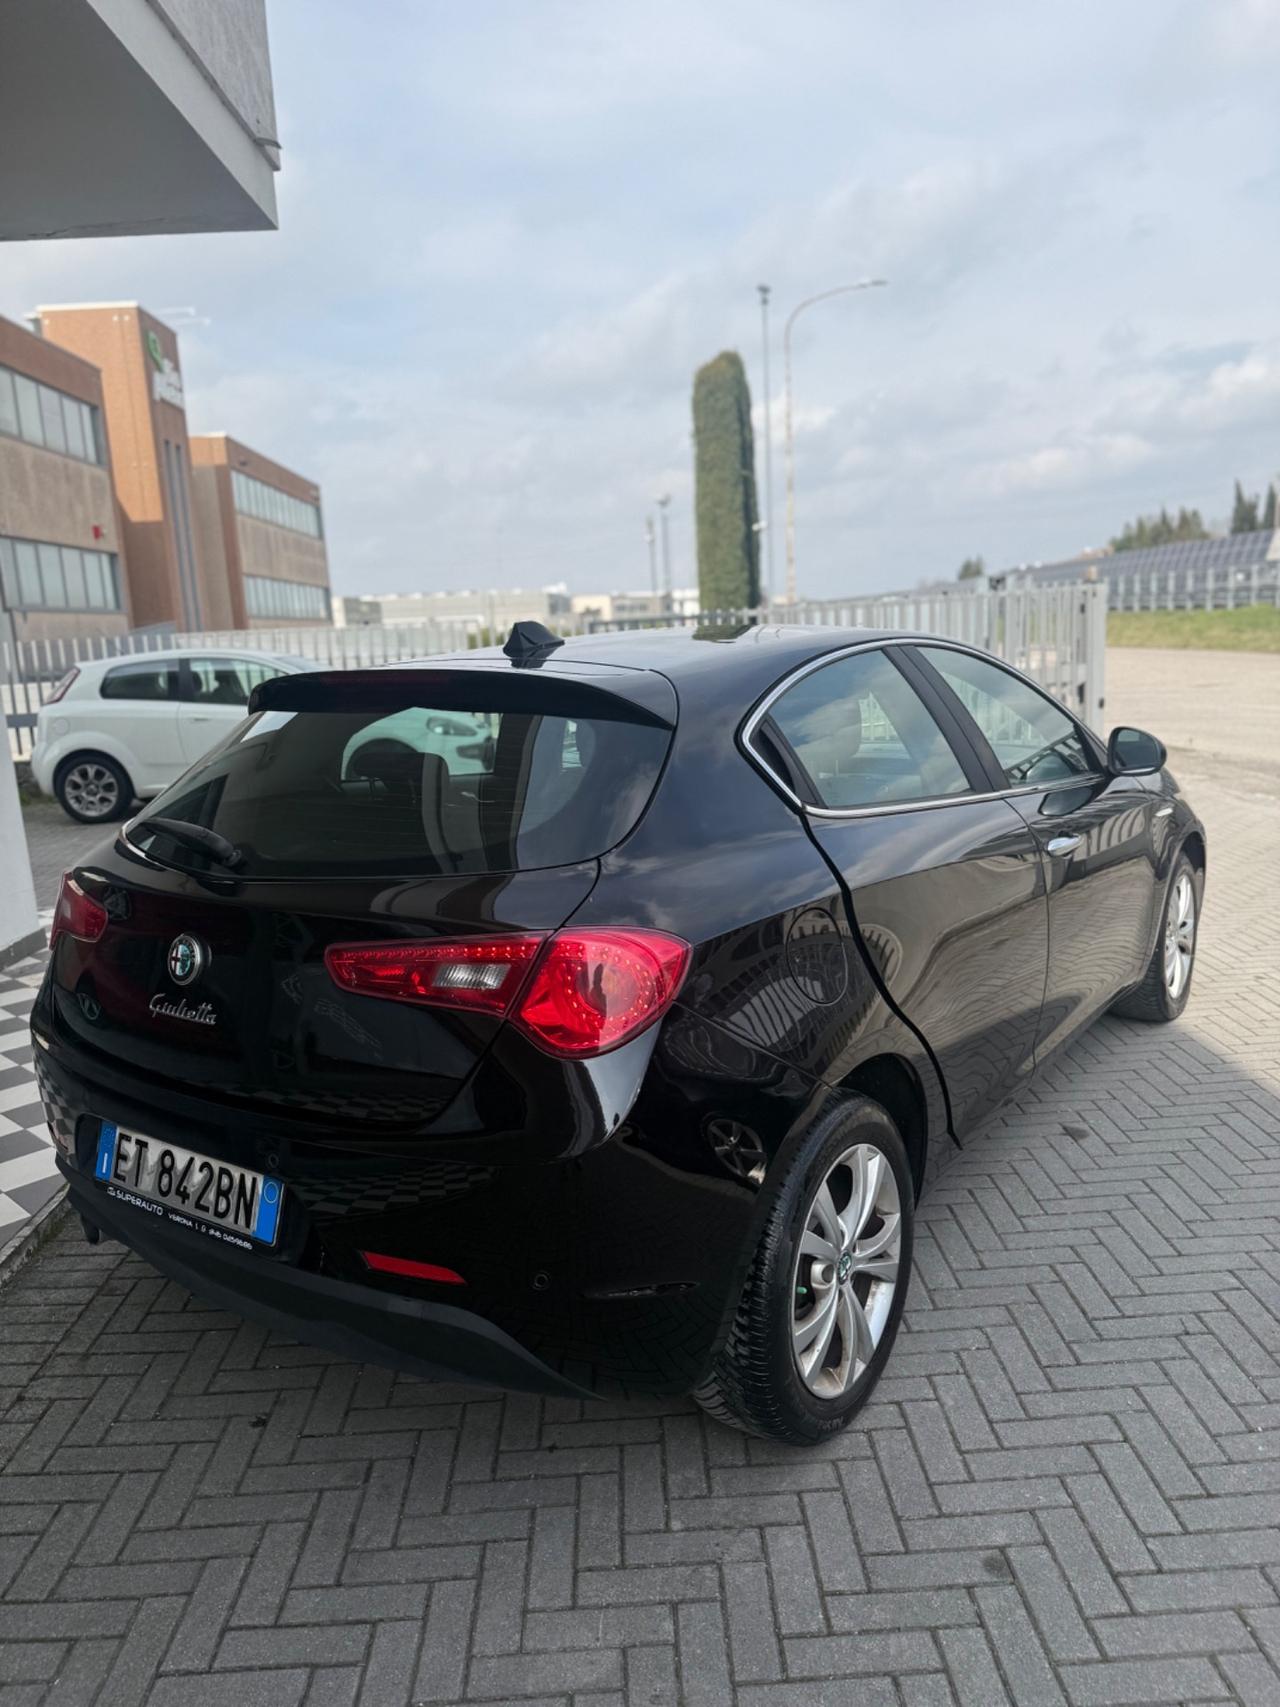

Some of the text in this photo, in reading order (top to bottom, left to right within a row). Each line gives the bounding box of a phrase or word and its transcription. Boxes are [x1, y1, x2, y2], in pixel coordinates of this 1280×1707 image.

[149, 993, 217, 1026] Giulietta
[112, 1132, 258, 1229] ET 842BN
[116, 1189, 164, 1216] SUPERAUTO
